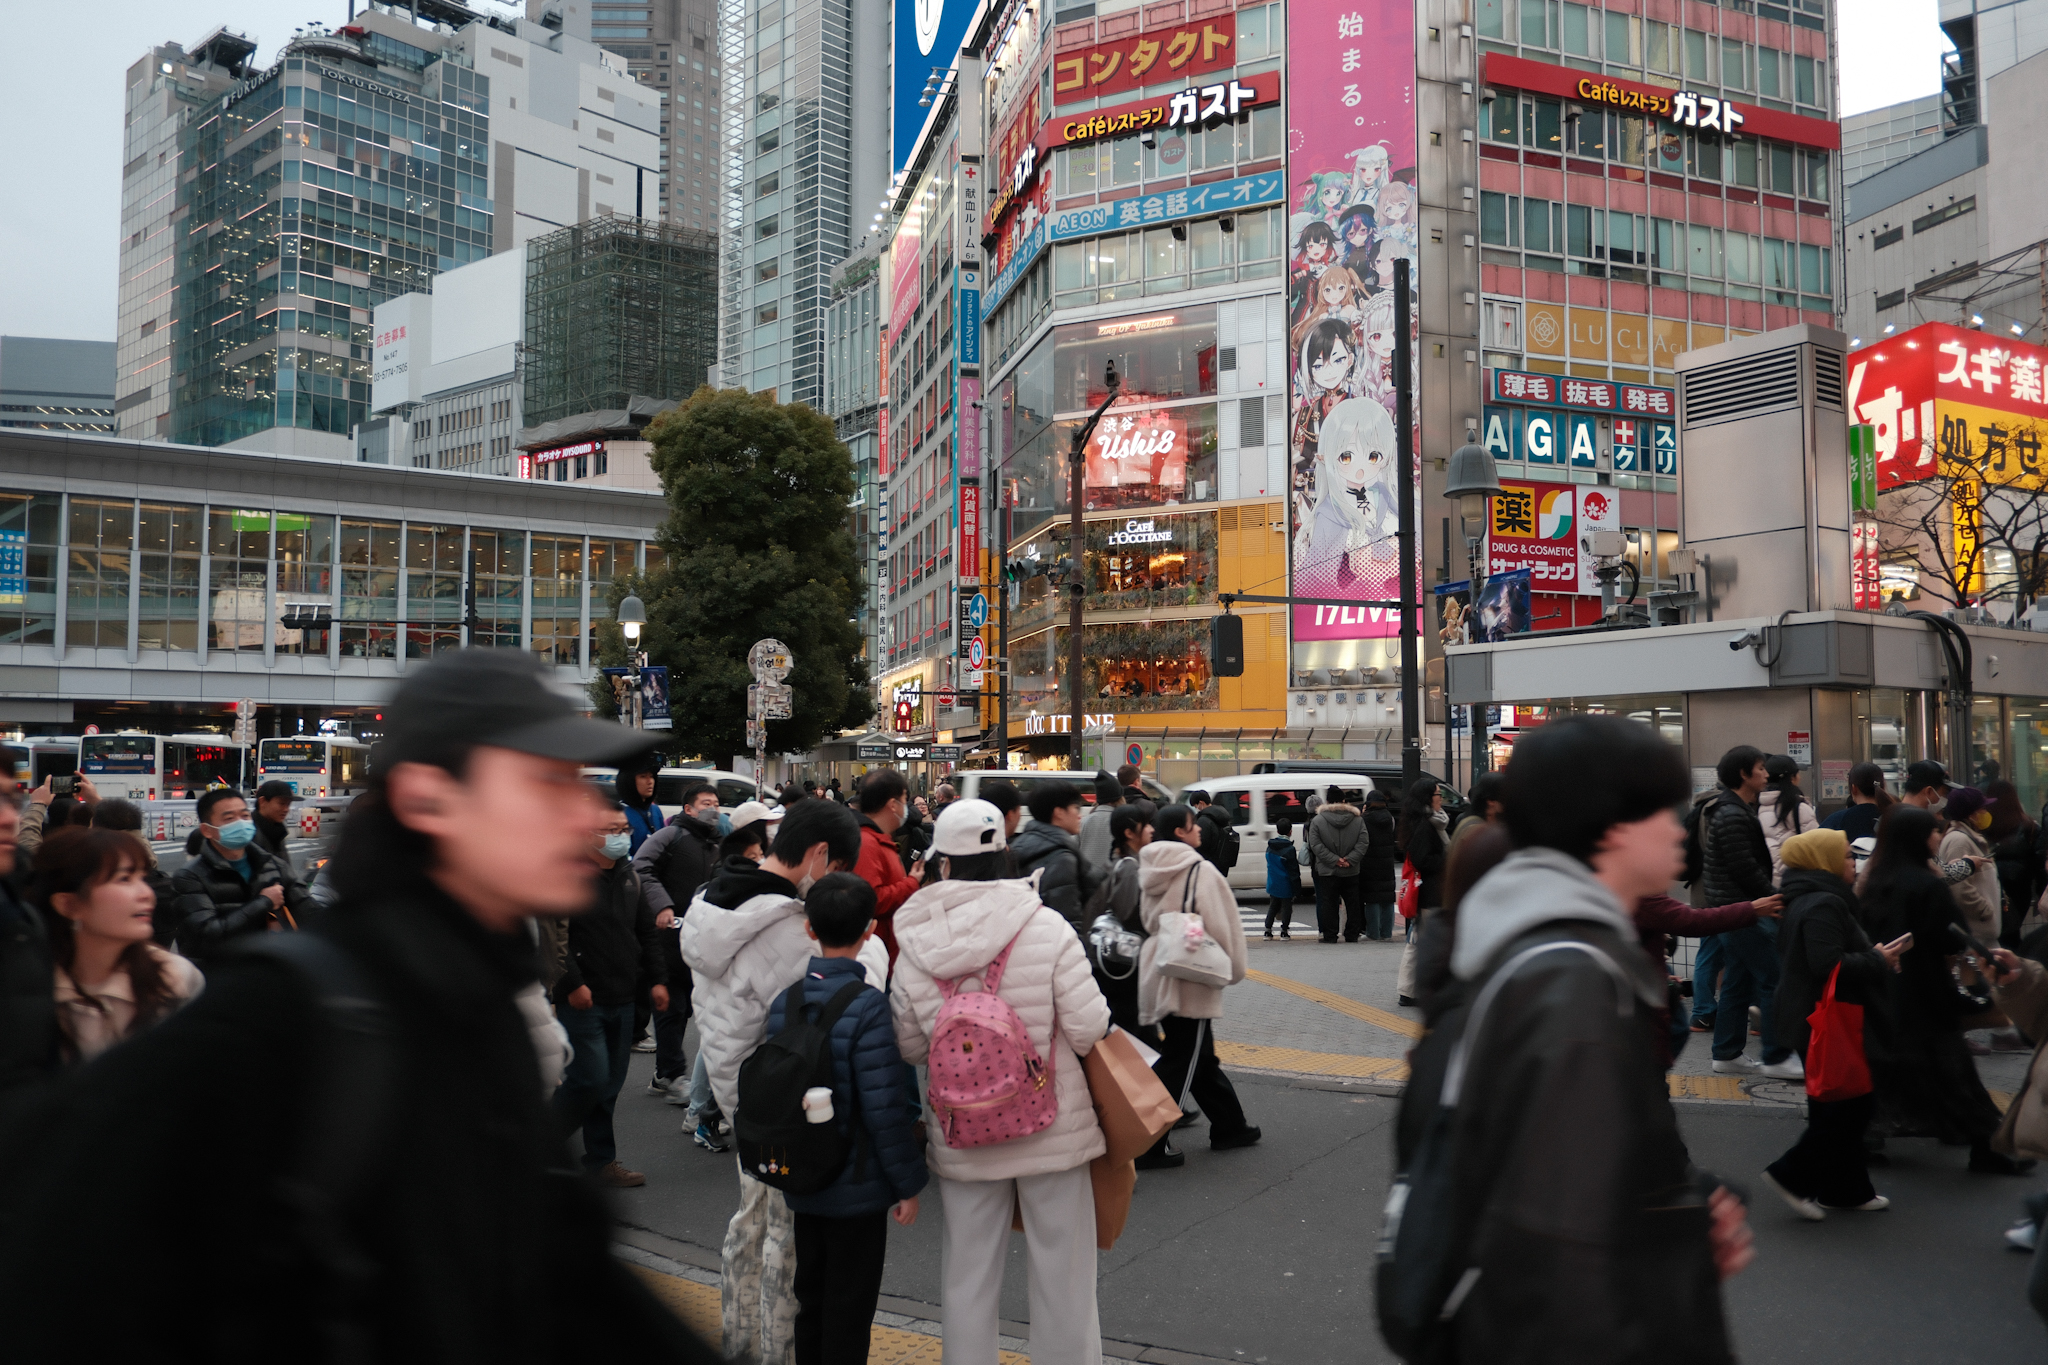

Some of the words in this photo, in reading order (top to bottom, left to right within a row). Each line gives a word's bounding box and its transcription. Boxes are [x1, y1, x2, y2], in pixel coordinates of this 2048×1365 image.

[1056, 25, 1231, 92] コンタクト
[1338, 11, 1364, 126] 始まる。
[320, 66, 364, 88] TOKYU
[367, 83, 411, 104] PLAZA
[1063, 106, 1164, 142] Caféレストラン
[1168, 80, 1256, 128] ガスト
[1578, 77, 1670, 114] Caféレストラン
[1672, 90, 1744, 134] ガスト
[1013, 142, 1037, 197] ガスト
[1071, 149, 1095, 161] OPEN
[965, 188, 976, 248] 献血ルーム
[1056, 208, 1107, 233] AEON
[376, 325, 407, 349] 広告募集
[1097, 327, 1117, 337] King
[1132, 318, 1174, 332] Yakiniku
[1572, 322, 1668, 353] LUCIA
[1503, 373, 1550, 401] 薄毛
[1938, 343, 2048, 404] スギ薬
[1566, 381, 1612, 408] 抜毛
[1627, 388, 1670, 415] 発毛
[537, 449, 562, 463] カラオケ
[562, 443, 592, 458] JOYSOUND
[1864, 453, 1873, 481] レイク
[962, 465, 976, 475] 4F
[964, 487, 977, 536] 外貨両替
[1495, 490, 1533, 534] 薬
[1491, 542, 1519, 554] DRUG
[1520, 544, 1528, 554] &
[1528, 545, 1575, 558] COSMETIC
[964, 577, 976, 585] 7F
[1867, 558, 1879, 593] アコム
